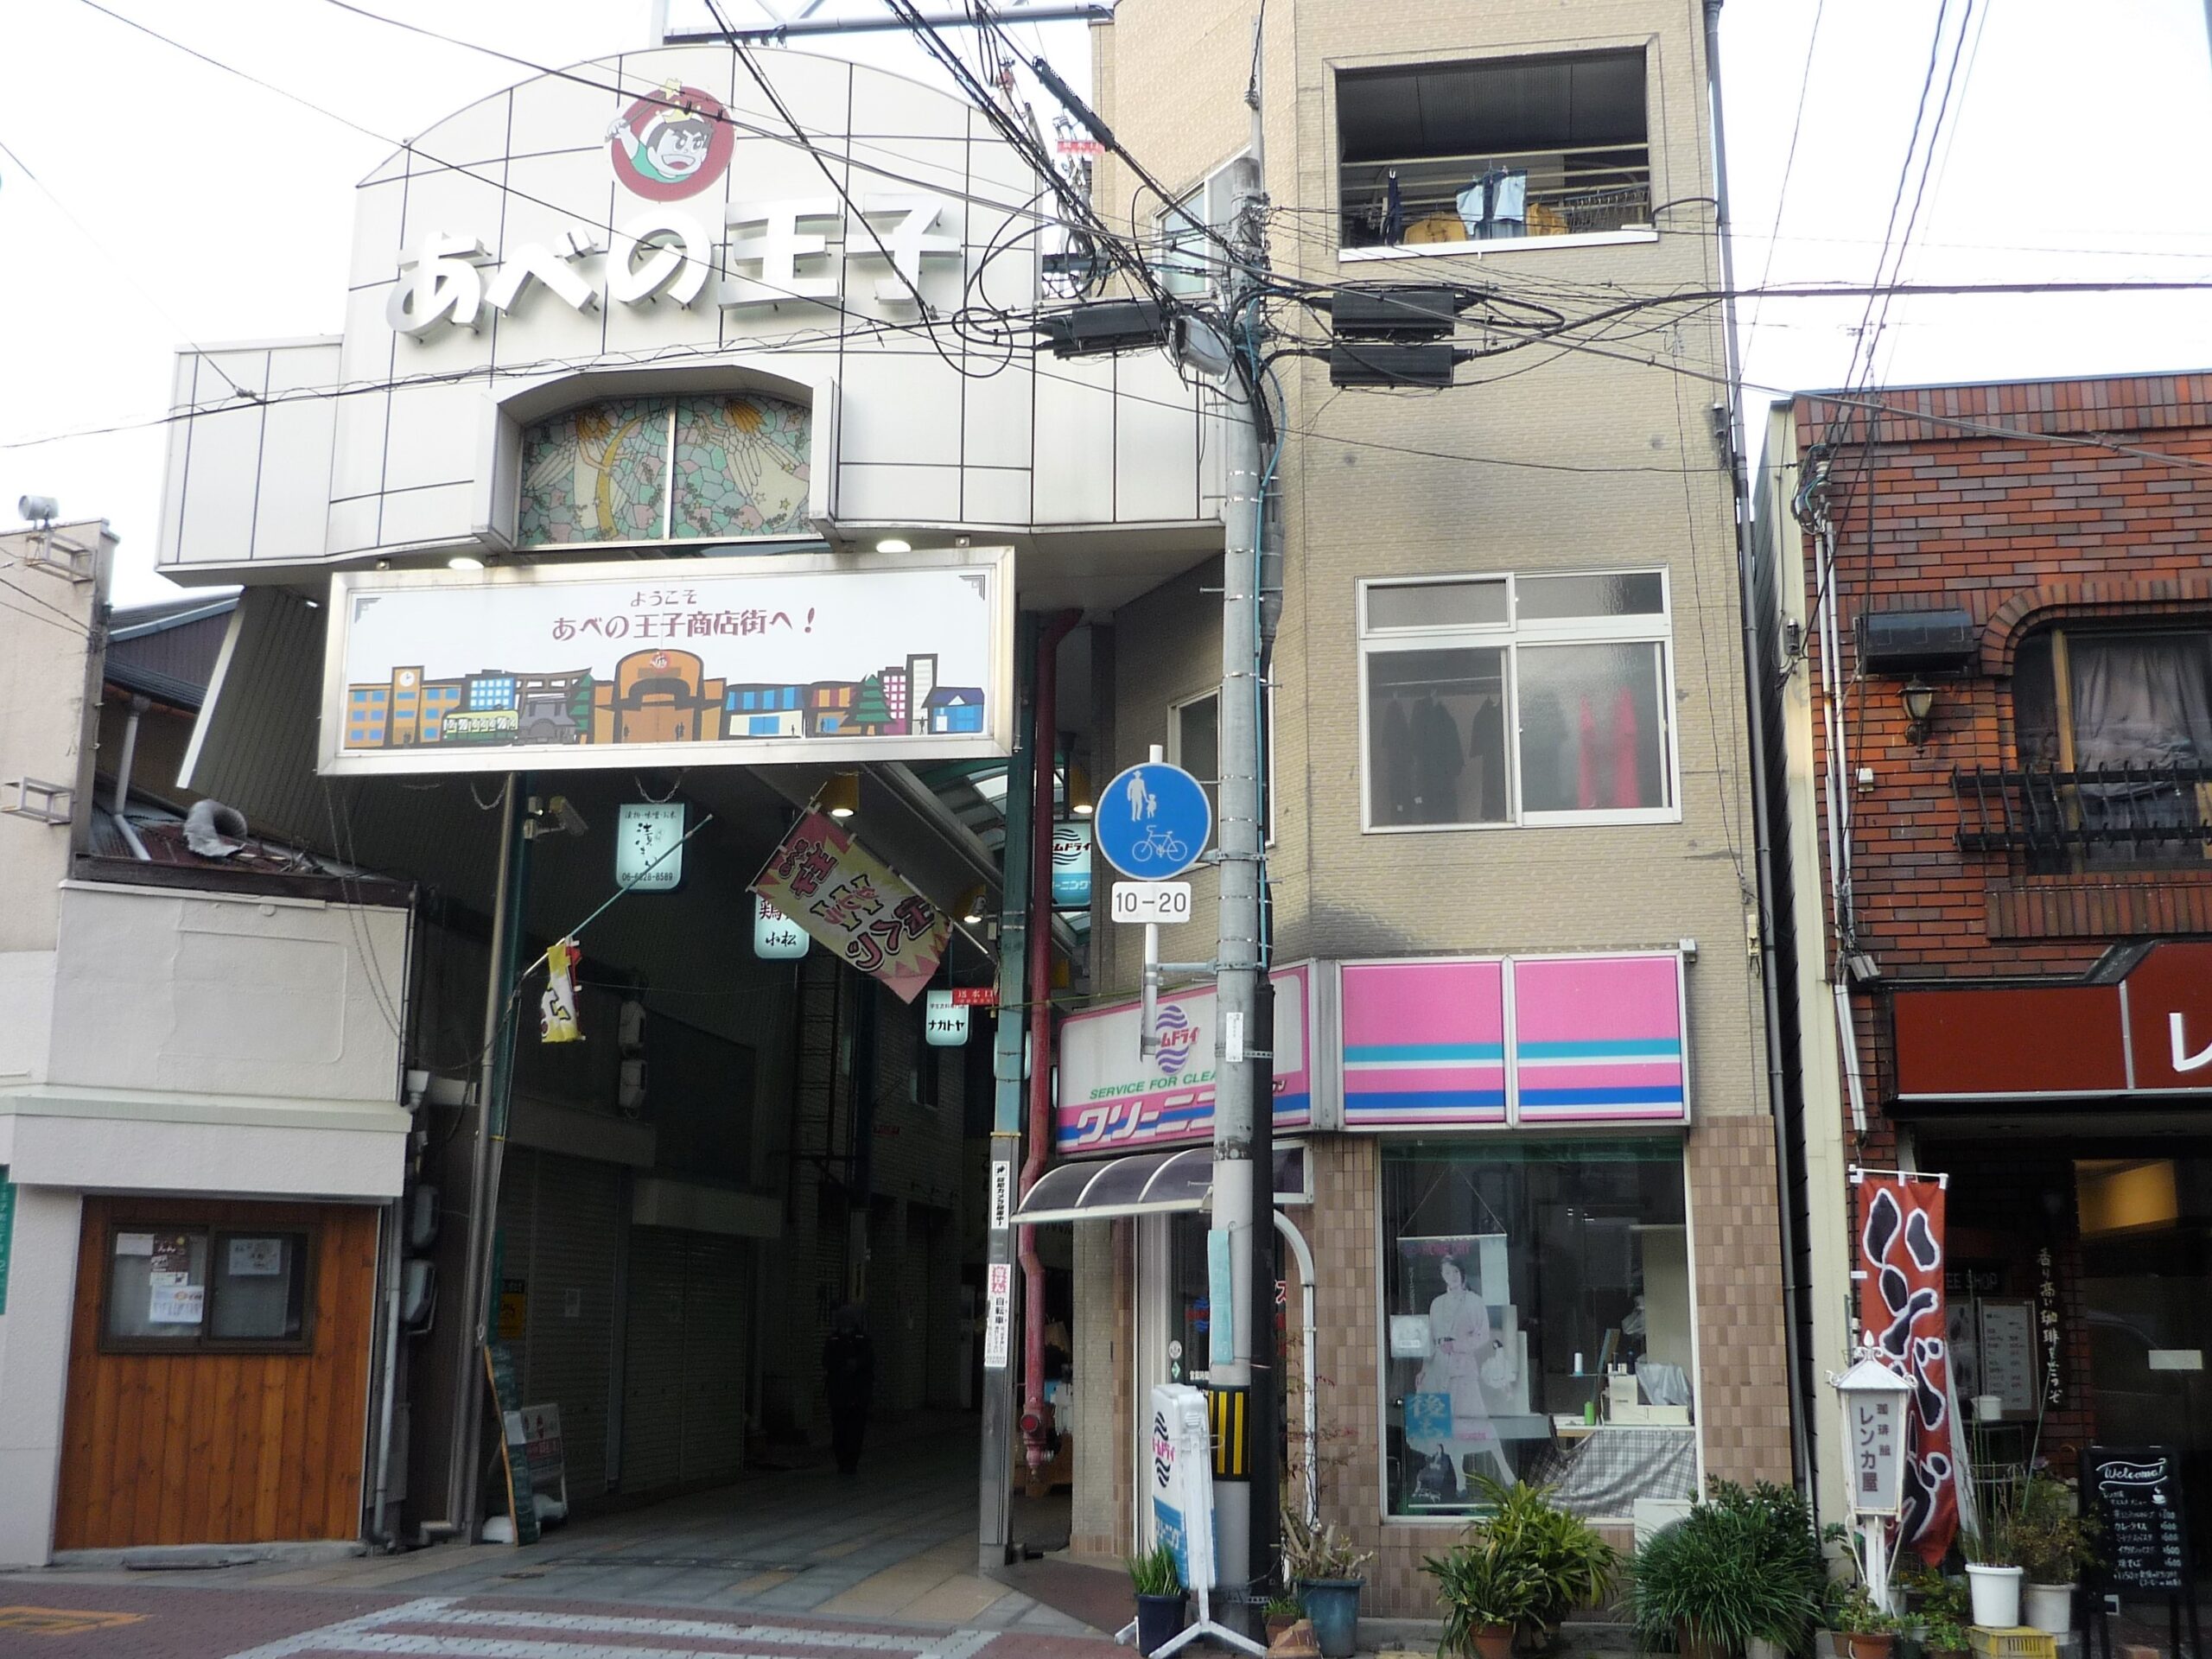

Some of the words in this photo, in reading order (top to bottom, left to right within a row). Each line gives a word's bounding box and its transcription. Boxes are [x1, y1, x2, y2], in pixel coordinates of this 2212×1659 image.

[385, 193, 963, 340] あべの王子
[631, 589, 697, 607] ようこそ
[1052, 842, 1090, 852] ムドライ
[1116, 893, 1186, 913] 10-20
[766, 931, 797, 947] 小松
[928, 1020, 965, 1031] ナカトヤ
[1090, 1081, 1144, 1100] SERVICE
[1149, 1075, 1178, 1090] FOR
[1183, 1071, 1217, 1085] CLEA
[2104, 1465, 2163, 1480] Welcome!
